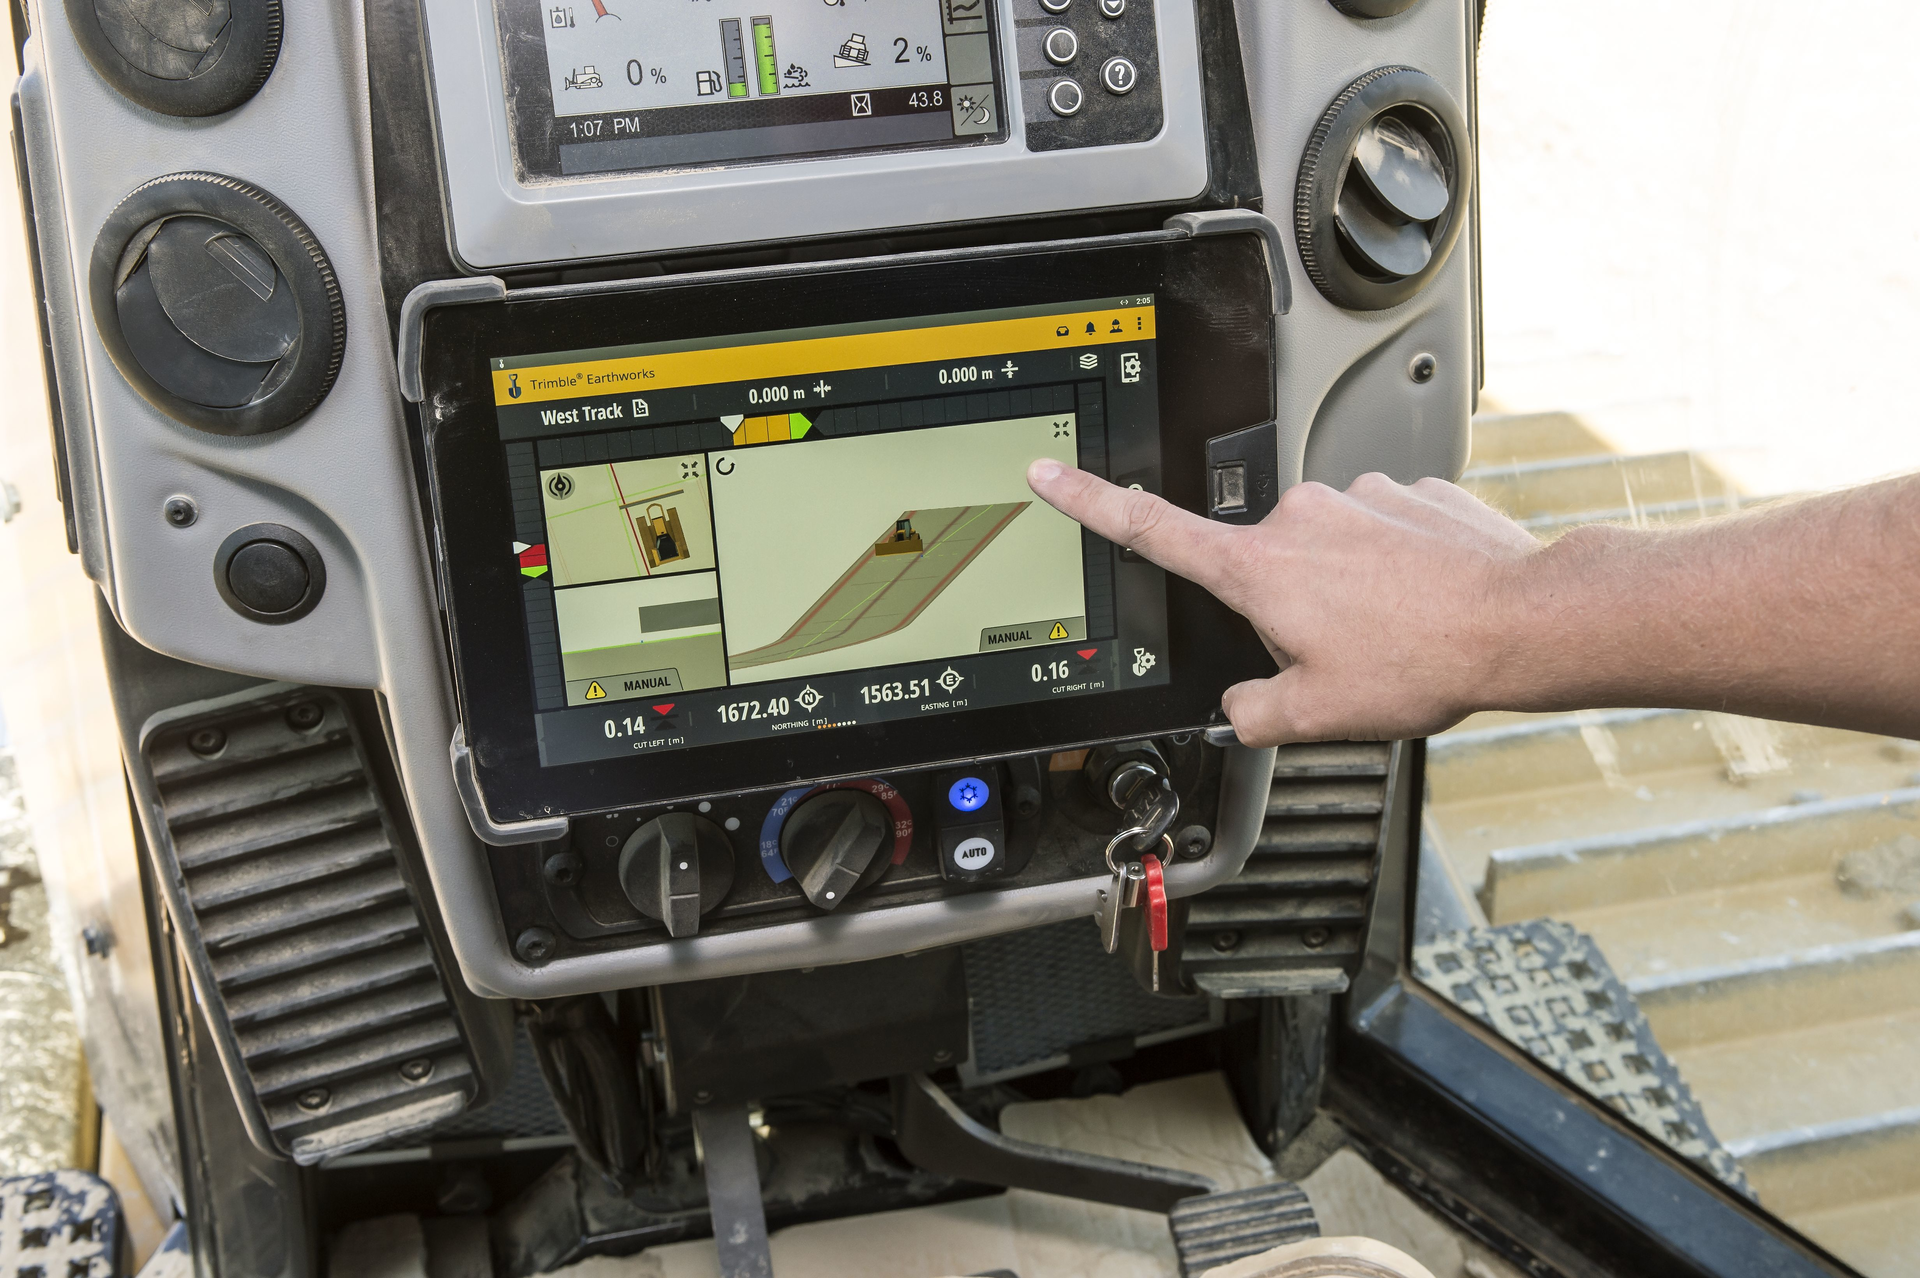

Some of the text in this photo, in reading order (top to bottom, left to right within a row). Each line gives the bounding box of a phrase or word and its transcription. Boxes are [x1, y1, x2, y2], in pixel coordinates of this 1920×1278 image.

[893, 37, 910, 63] 2
[626, 59, 643, 86] 0
[908, 90, 943, 108] 43.8
[569, 117, 640, 138] 1:07 PM
[1136, 296, 1151, 305] 2:05
[586, 368, 656, 386] Earthworks
[938, 366, 993, 385] 0.000 m
[748, 386, 805, 404] 0.000 m
[540, 402, 624, 426] West Track
[987, 630, 1033, 645] MANUAL
[1031, 660, 1070, 683] 0.16
[624, 676, 672, 692] MANUAL
[860, 678, 931, 705] 1563.51
[1052, 684, 1067, 694] CUT
[1067, 682, 1087, 692] RIGHT
[717, 697, 790, 724] 1672.40
[920, 700, 950, 711] EASTING
[604, 716, 646, 739] 0.14
[771, 719, 809, 731] NORTHING
[633, 741, 648, 750] CUT
[648, 738, 665, 748] LEFT
[962, 847, 987, 859] AUTO
